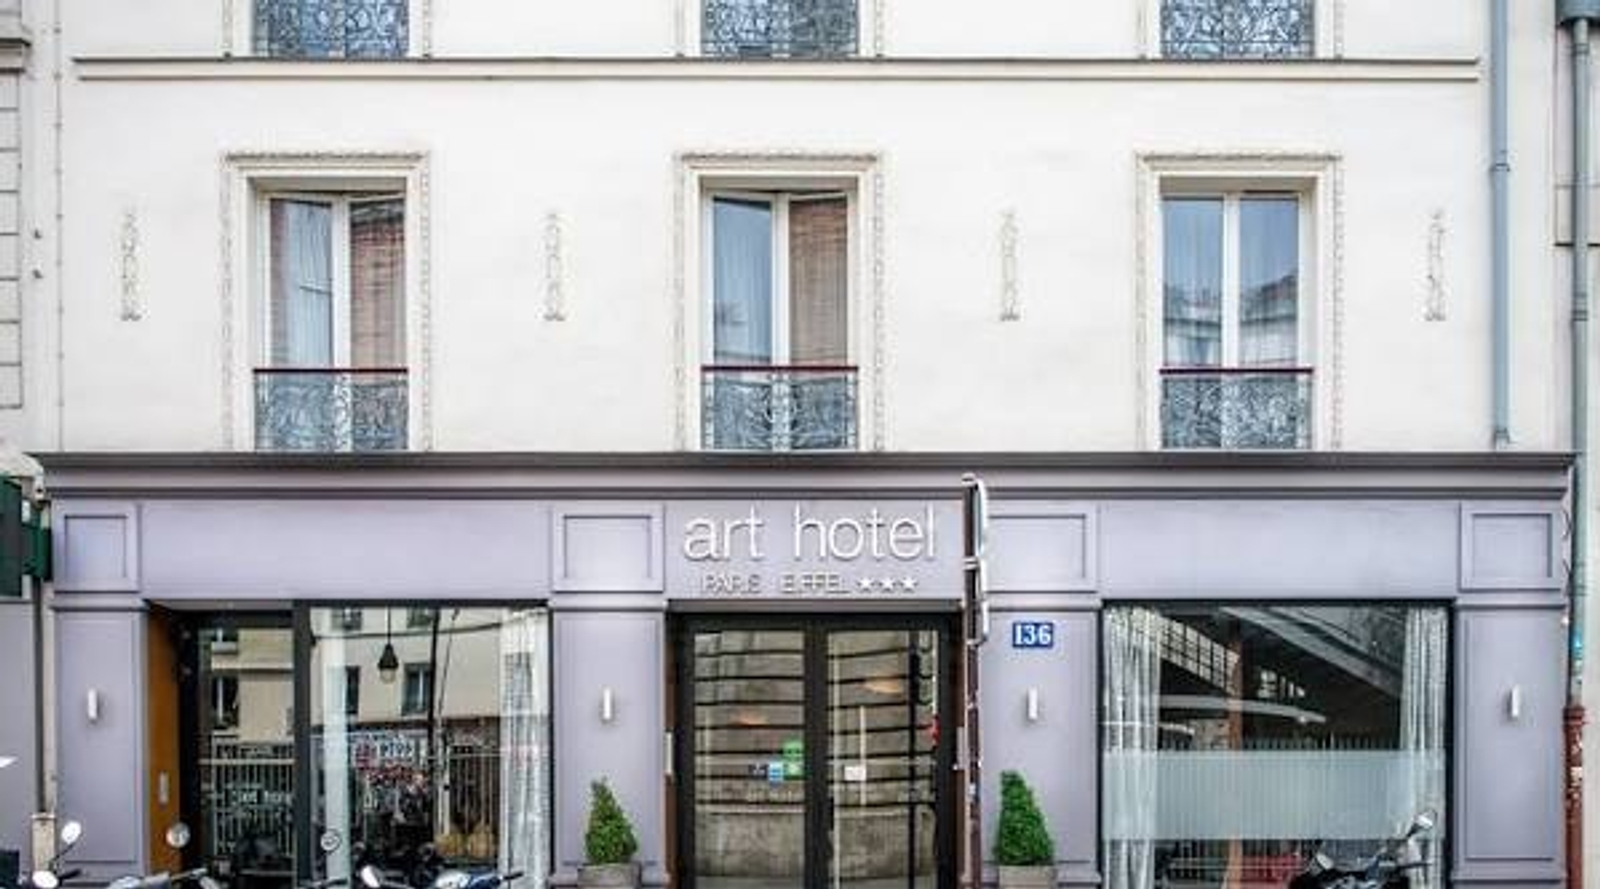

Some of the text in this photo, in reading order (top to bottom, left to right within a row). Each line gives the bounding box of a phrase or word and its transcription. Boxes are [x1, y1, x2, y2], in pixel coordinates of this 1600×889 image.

[683, 501, 936, 561] art hotel
[1014, 624, 1052, 646] 136
